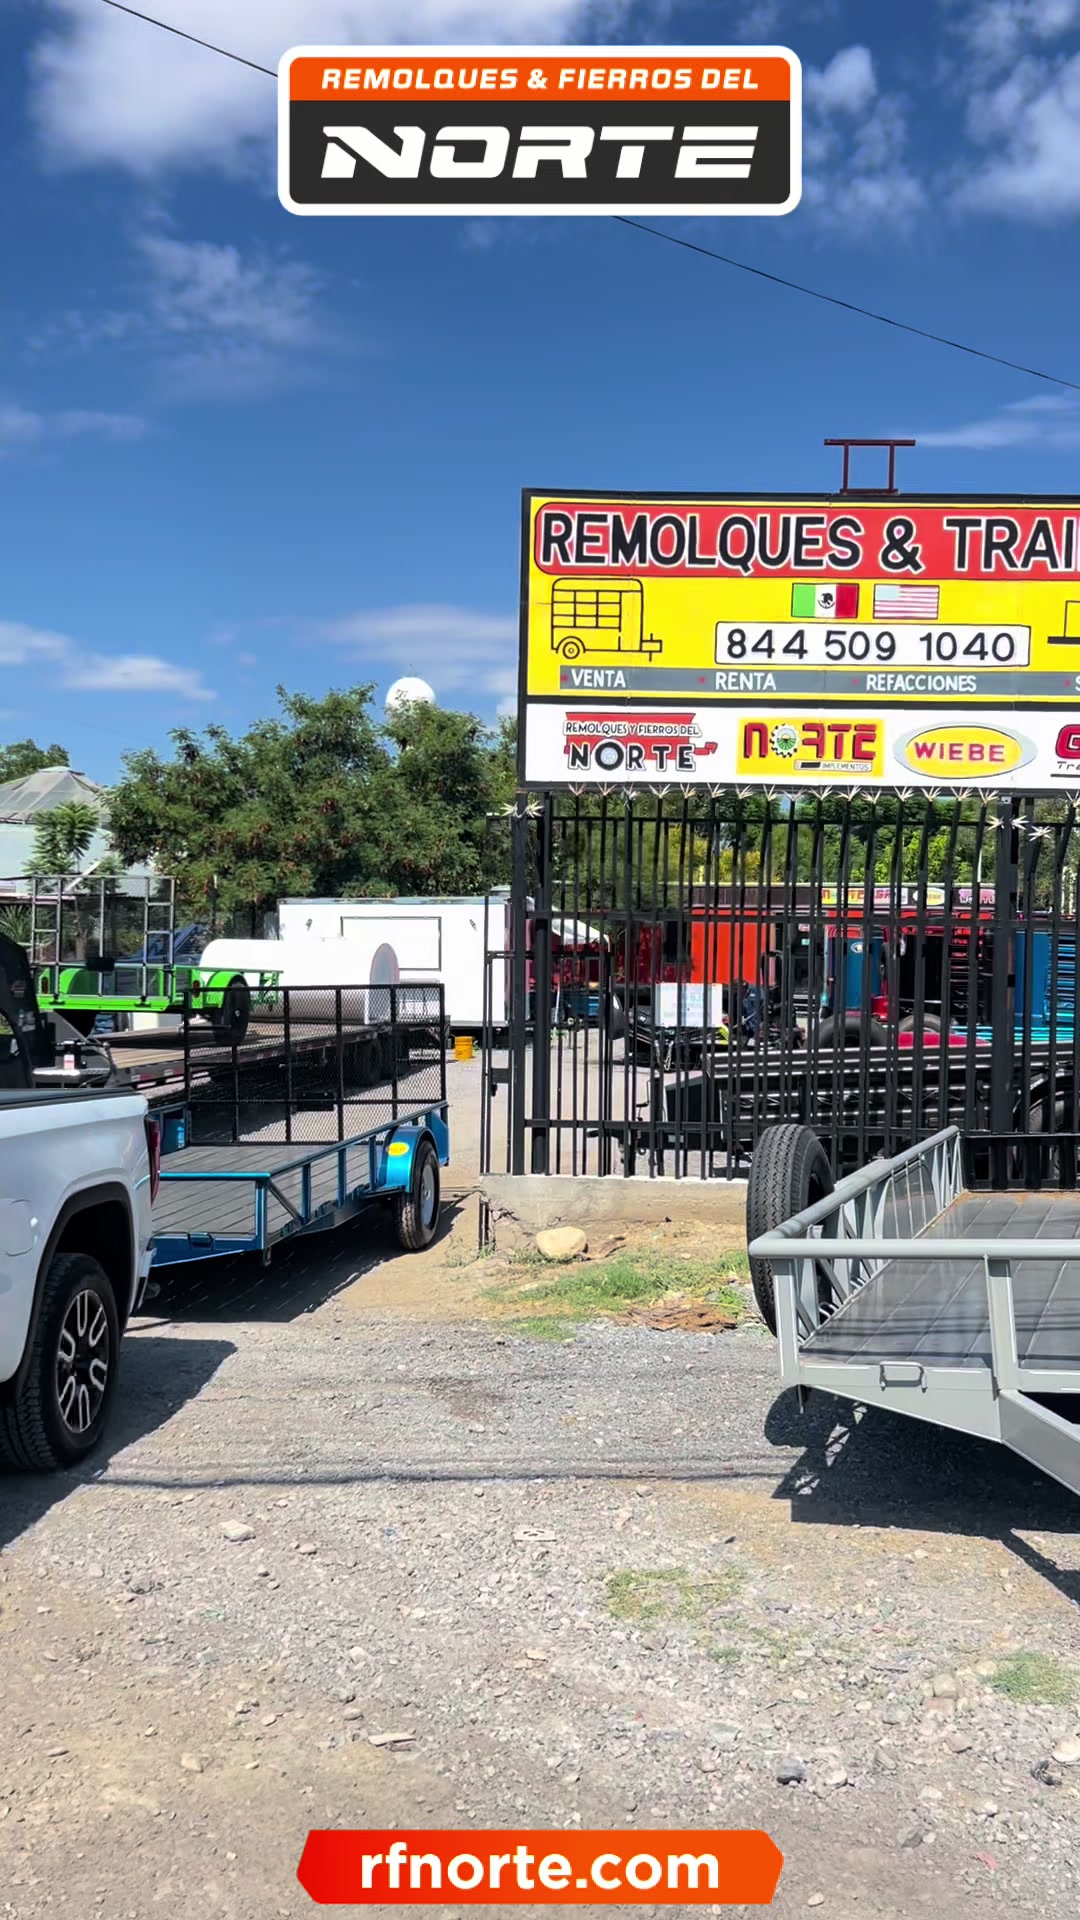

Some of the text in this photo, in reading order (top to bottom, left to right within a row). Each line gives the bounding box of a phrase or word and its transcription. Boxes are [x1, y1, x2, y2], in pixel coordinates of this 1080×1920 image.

[541, 511, 865, 576] REMOLQUES
[879, 515, 925, 574] &
[727, 628, 1016, 662] 844 509 1040
[571, 668, 627, 689] VENTA
[715, 671, 777, 691] RENTA
[866, 674, 977, 693] REFACCIONES
[565, 721, 699, 736] REMOLQUES Y FIERROS DEL
[570, 741, 694, 770] NORTE
[914, 742, 1005, 762] WIEBE
[822, 762, 869, 772] IMPLEMENTOS
